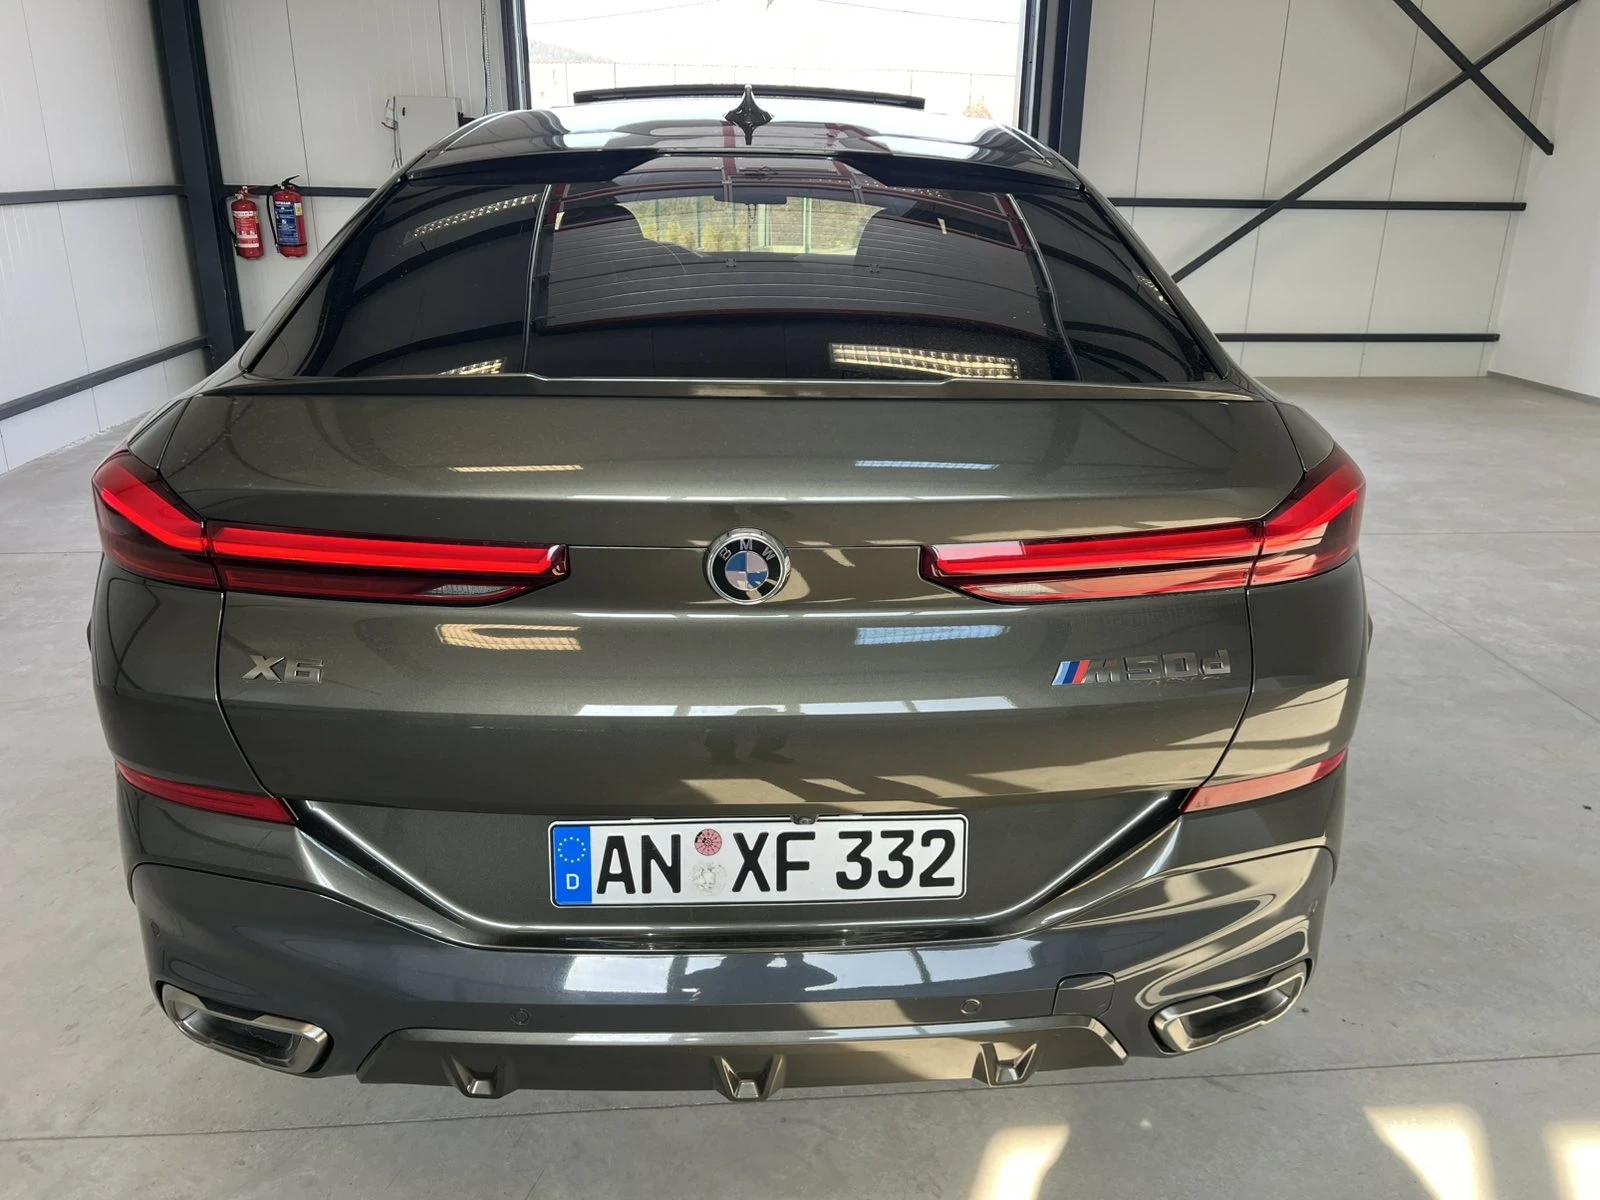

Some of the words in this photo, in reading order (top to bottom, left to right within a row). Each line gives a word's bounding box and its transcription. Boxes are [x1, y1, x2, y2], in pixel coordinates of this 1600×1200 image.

[719, 538, 776, 561] BMW
[241, 655, 324, 684] X6
[596, 833, 681, 894] AN
[732, 831, 816, 892] XF
[835, 829, 956, 890] 332
[566, 873, 580, 890] D
